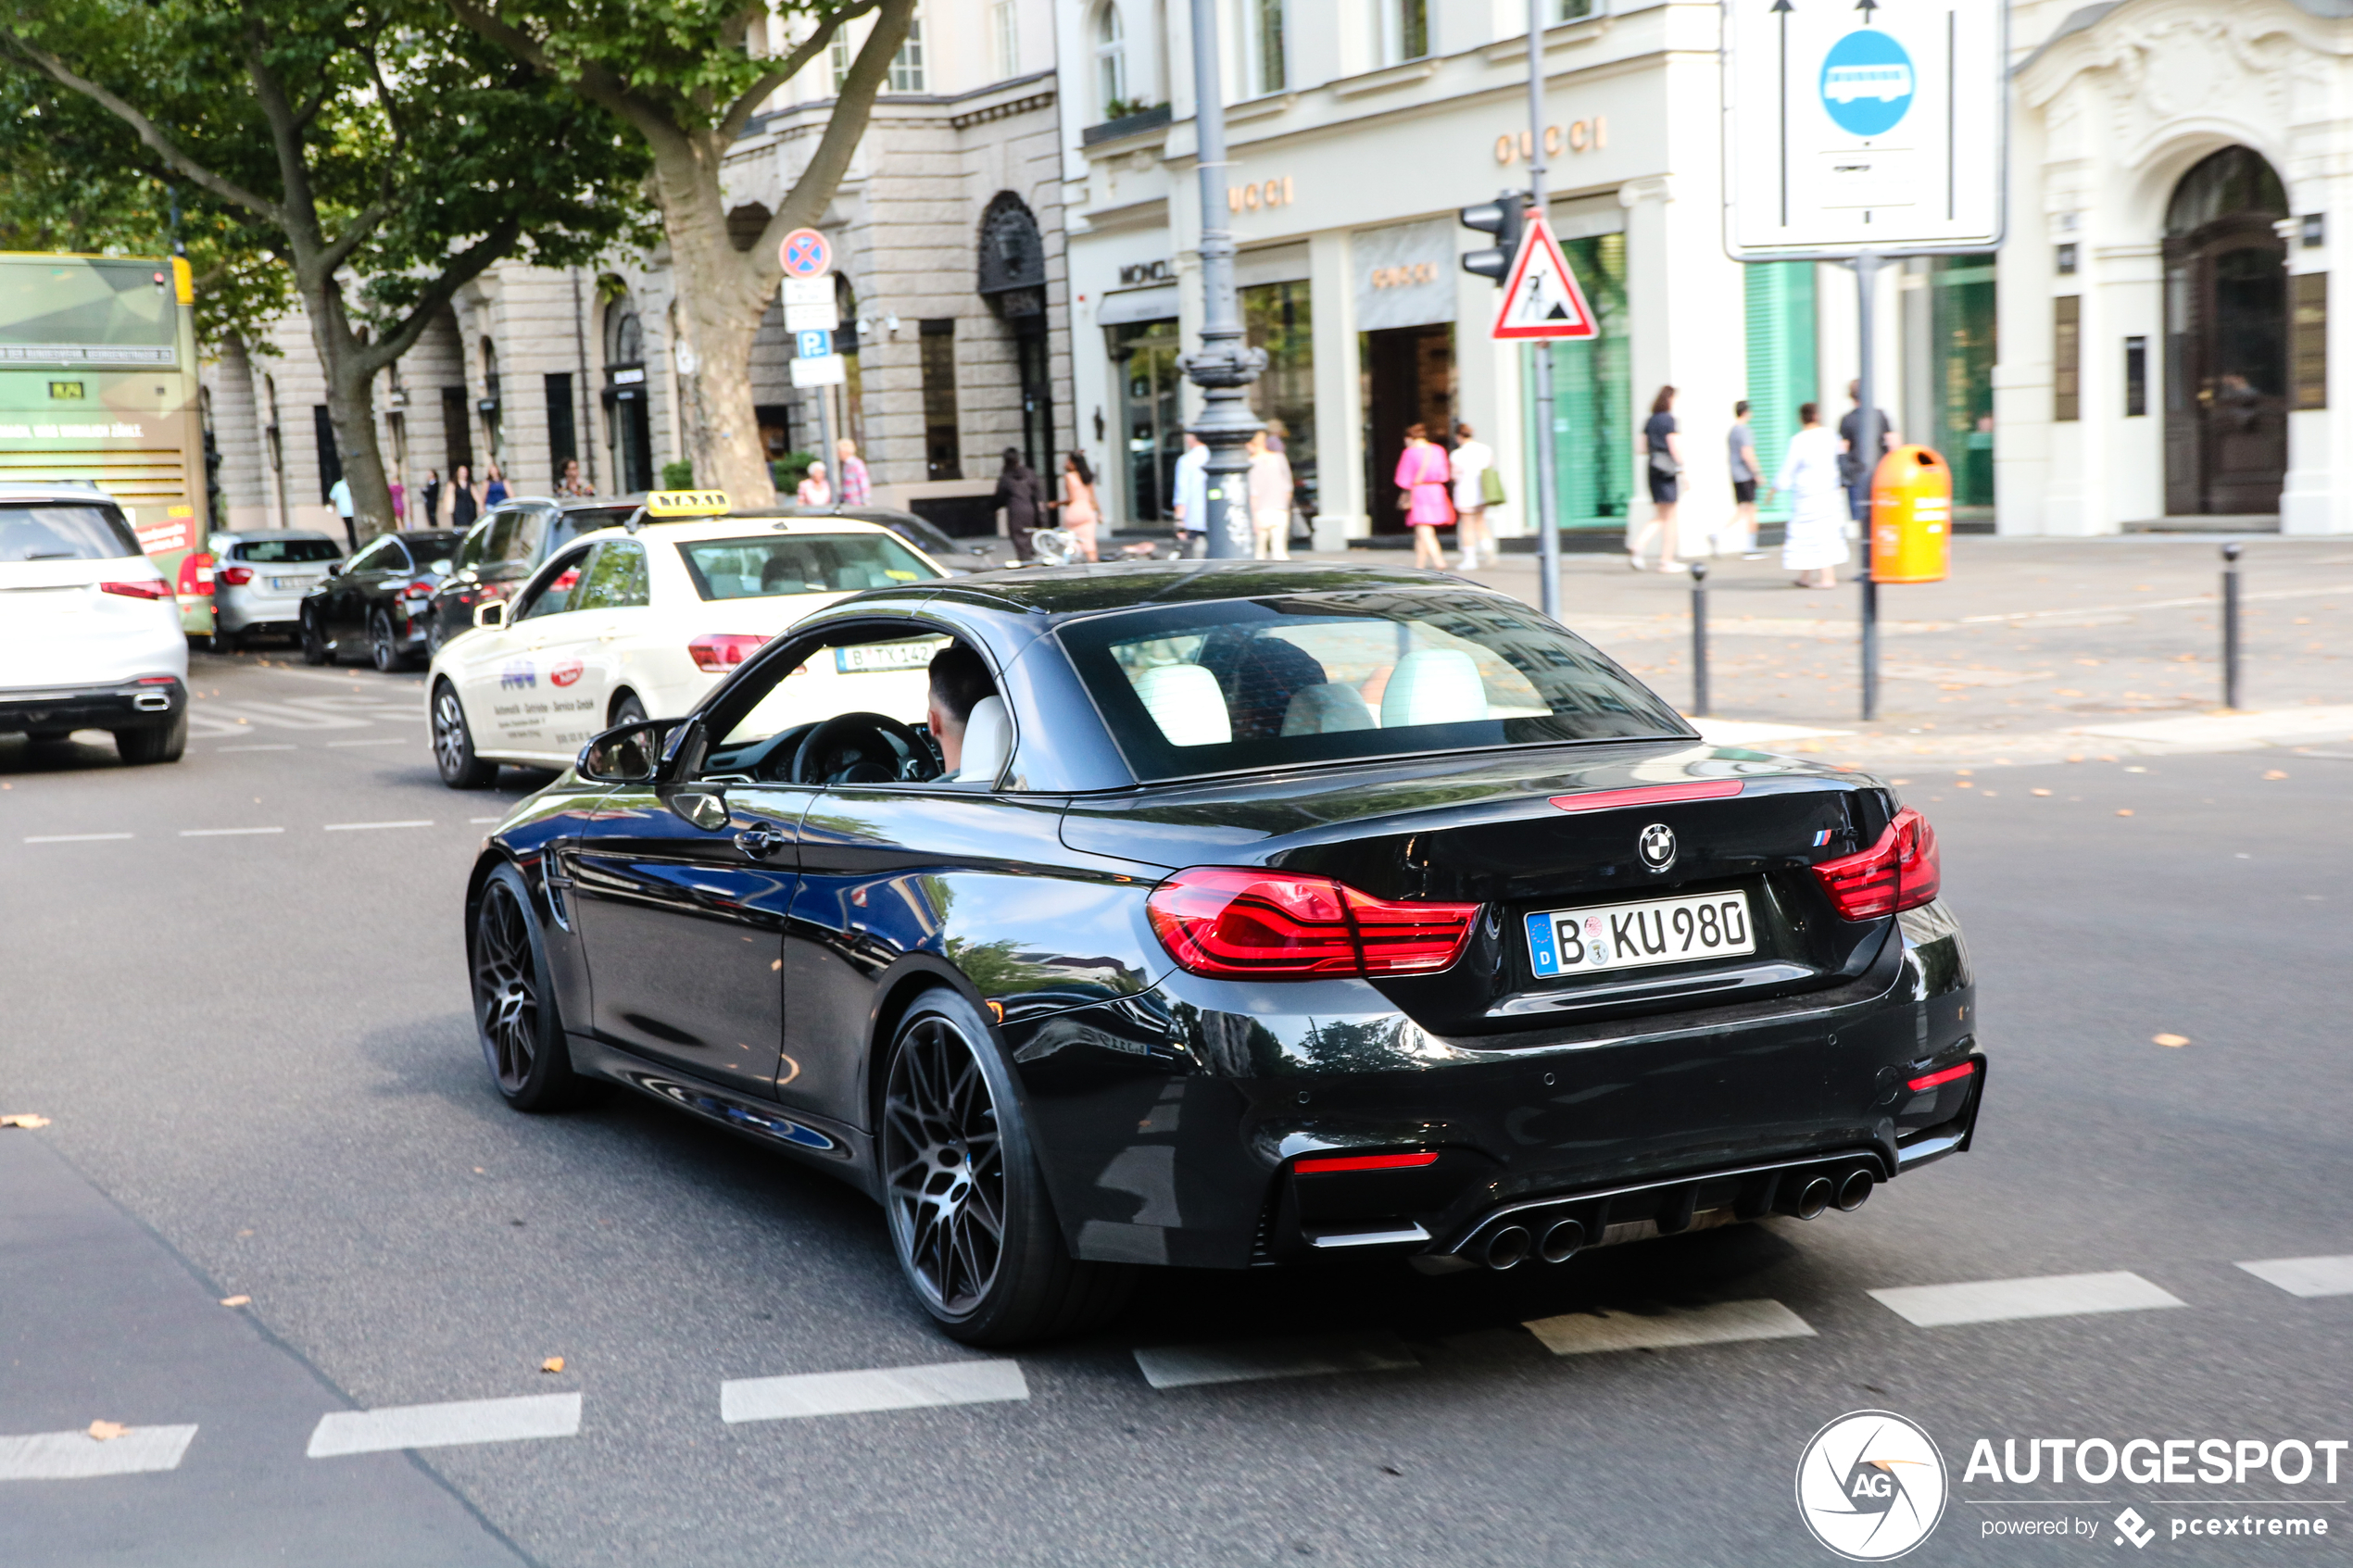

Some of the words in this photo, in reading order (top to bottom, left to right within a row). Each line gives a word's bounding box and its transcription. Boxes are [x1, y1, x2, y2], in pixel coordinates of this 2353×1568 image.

[1494, 116, 1608, 167] GUCCI
[1227, 175, 1294, 214] UCCI
[1119, 260, 1179, 285] MONCL
[801, 332, 822, 357] P
[660, 494, 725, 507] TAXI
[852, 650, 863, 666] B
[900, 646, 929, 663] 142
[1540, 951, 1551, 965] D
[1555, 919, 1585, 965] B
[1610, 909, 1667, 958] KU
[1672, 901, 1746, 951] 980
